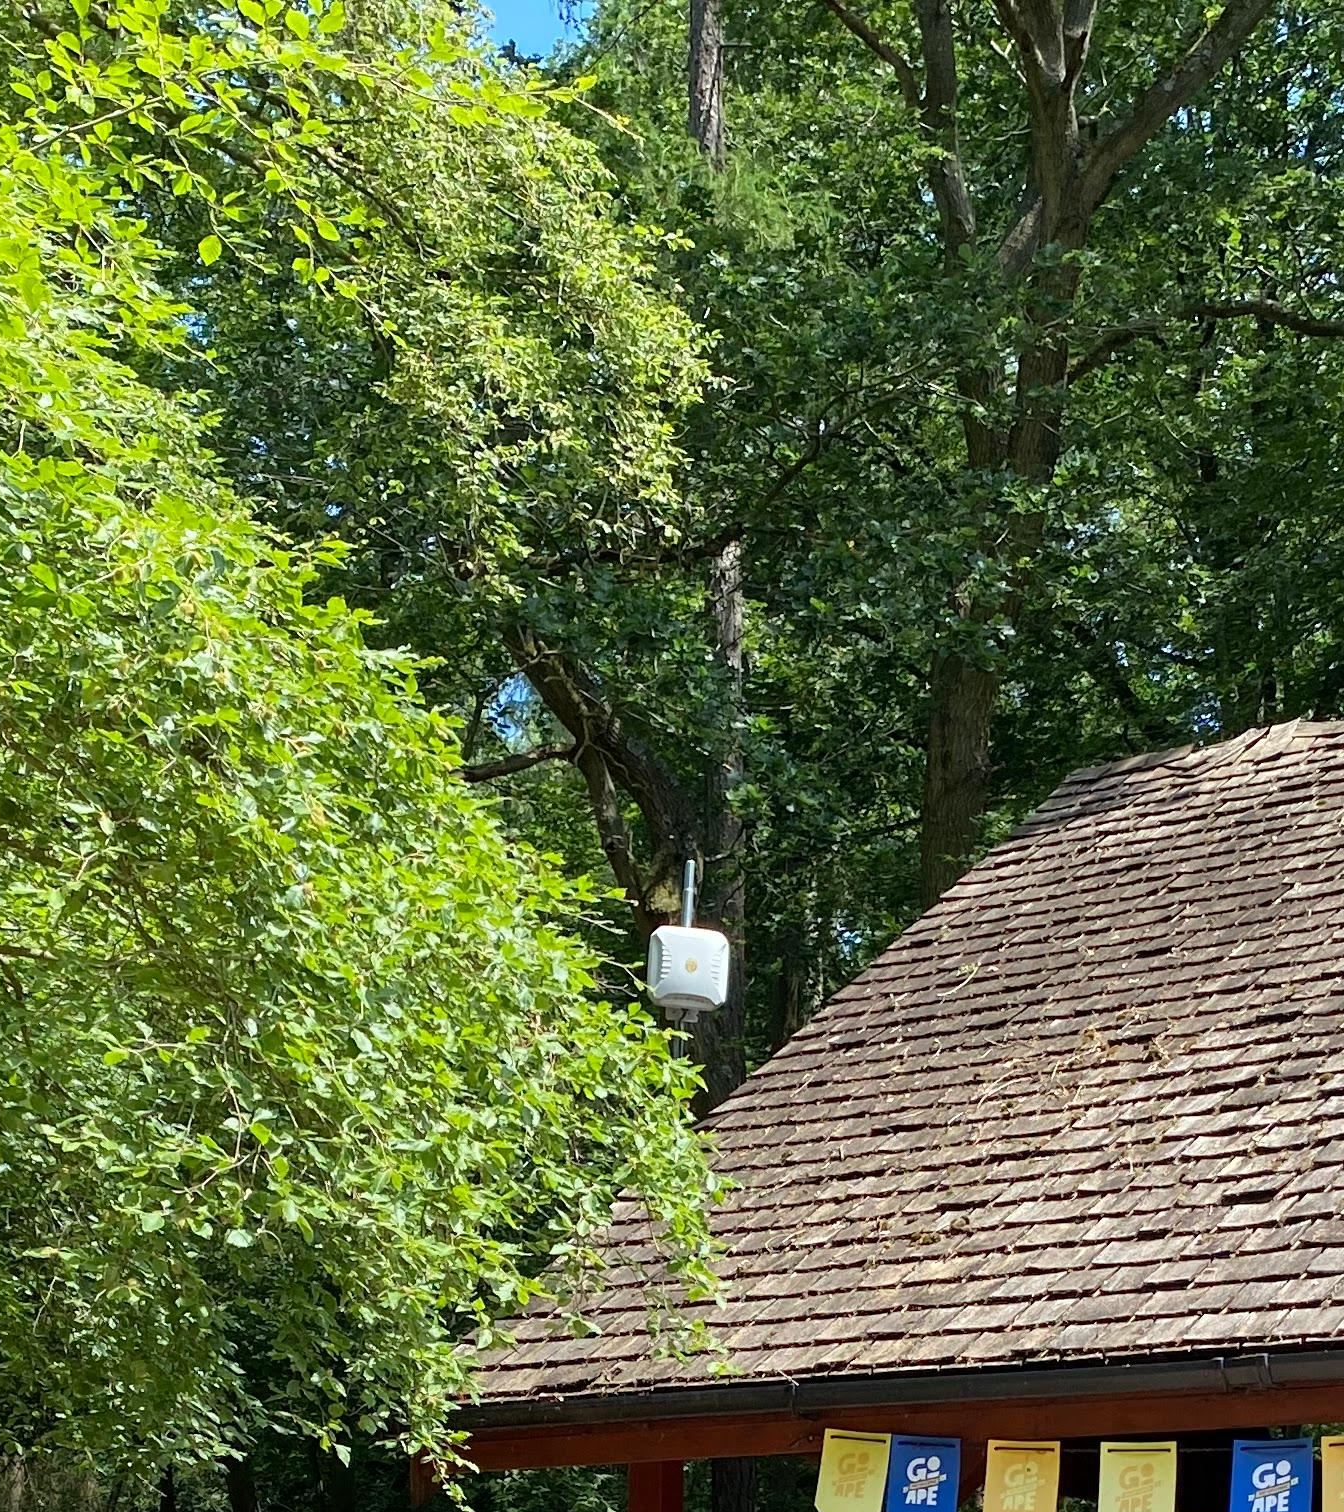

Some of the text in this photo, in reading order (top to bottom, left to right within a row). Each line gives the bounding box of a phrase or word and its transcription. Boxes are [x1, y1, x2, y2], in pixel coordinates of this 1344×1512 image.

[834, 1480, 864, 1499] APE
[905, 1486, 937, 1506] APE
[1002, 1492, 1035, 1511] APE
[1118, 1495, 1153, 1512] APE
[1251, 1489, 1289, 1512] APE
